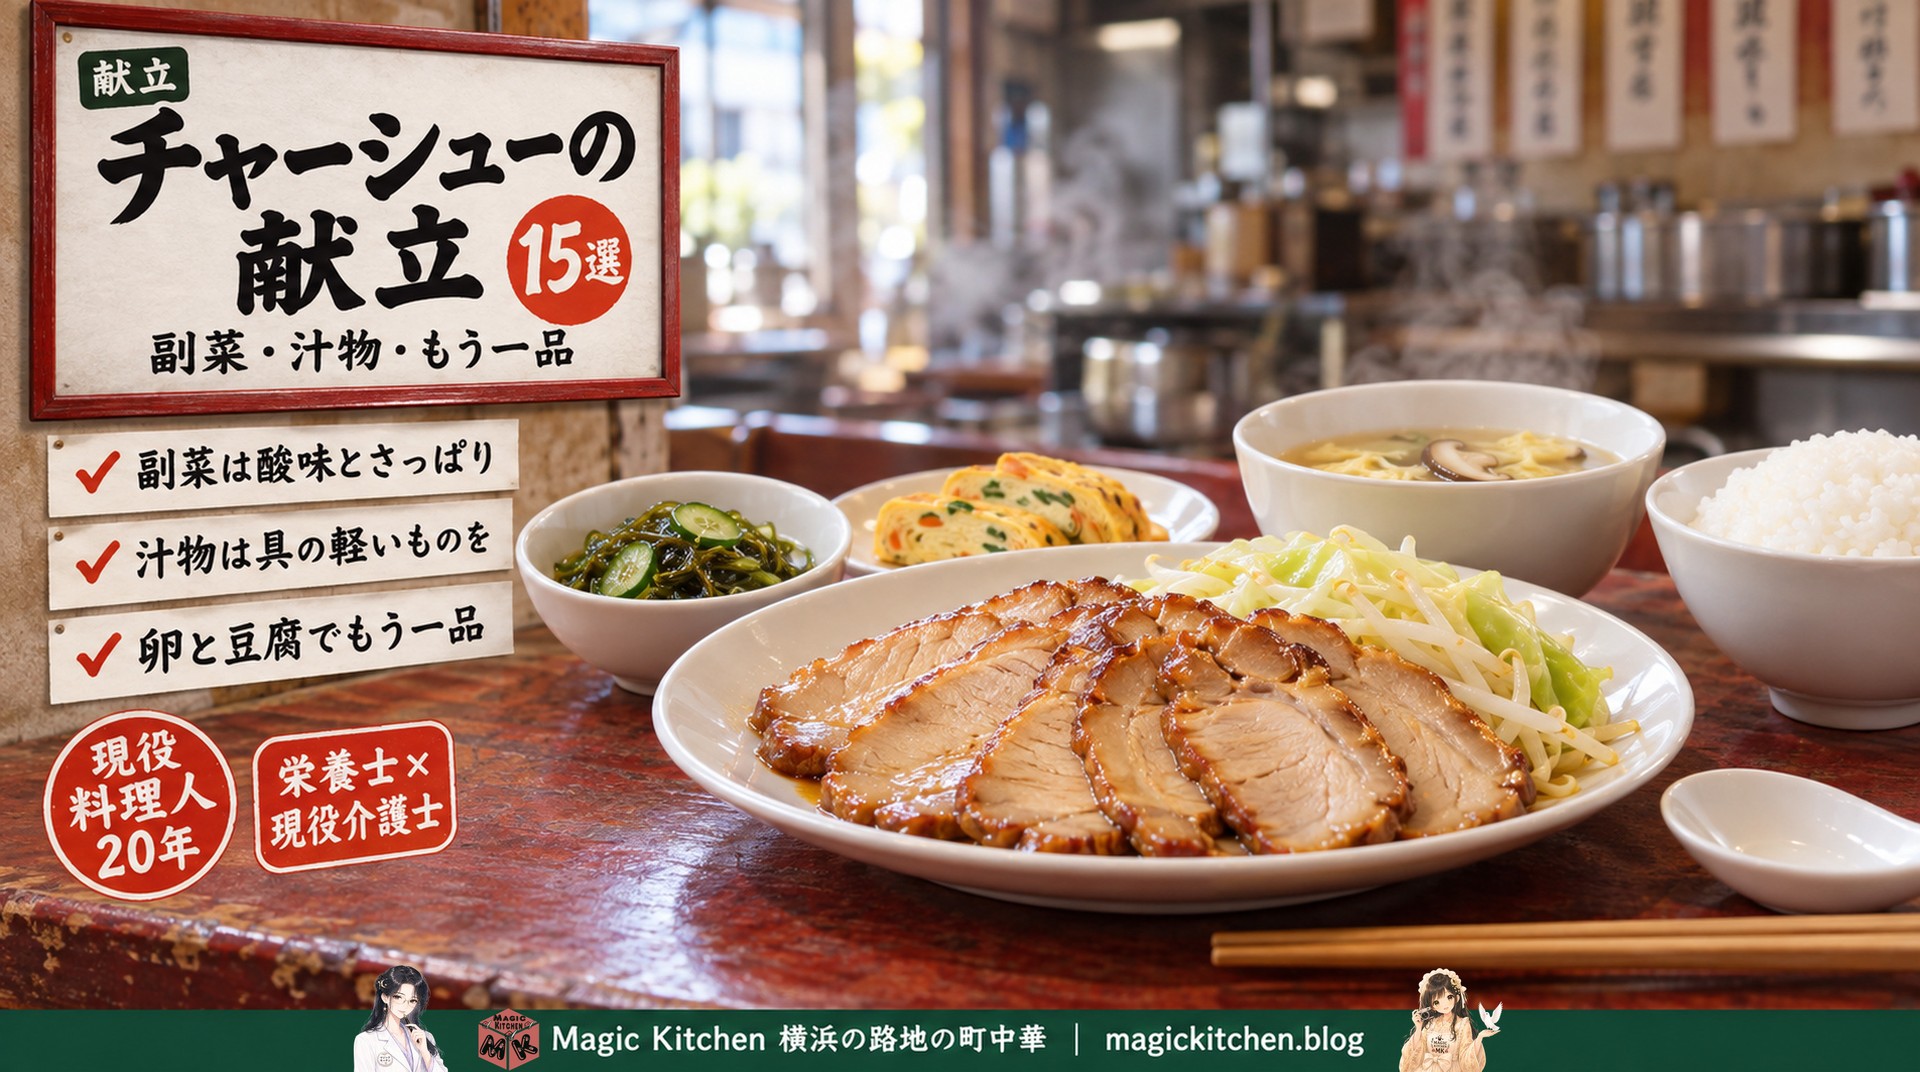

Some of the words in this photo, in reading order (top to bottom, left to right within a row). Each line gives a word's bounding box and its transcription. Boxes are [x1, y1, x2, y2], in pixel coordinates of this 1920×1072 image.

[92, 57, 178, 98] 献立
[97, 107, 636, 225] チャーシューの
[236, 203, 484, 317] 献立
[518, 220, 625, 295] 15選
[137, 439, 493, 491] 副菜は酸味とさっぱり
[136, 521, 490, 580] 汁物は具の軽いものを
[138, 605, 485, 675] 卵と豆腐でもう一品
[90, 729, 182, 779] 現役
[69, 771, 217, 832] 料理人
[270, 792, 444, 851] 現役介護士
[95, 825, 201, 880] 20年
